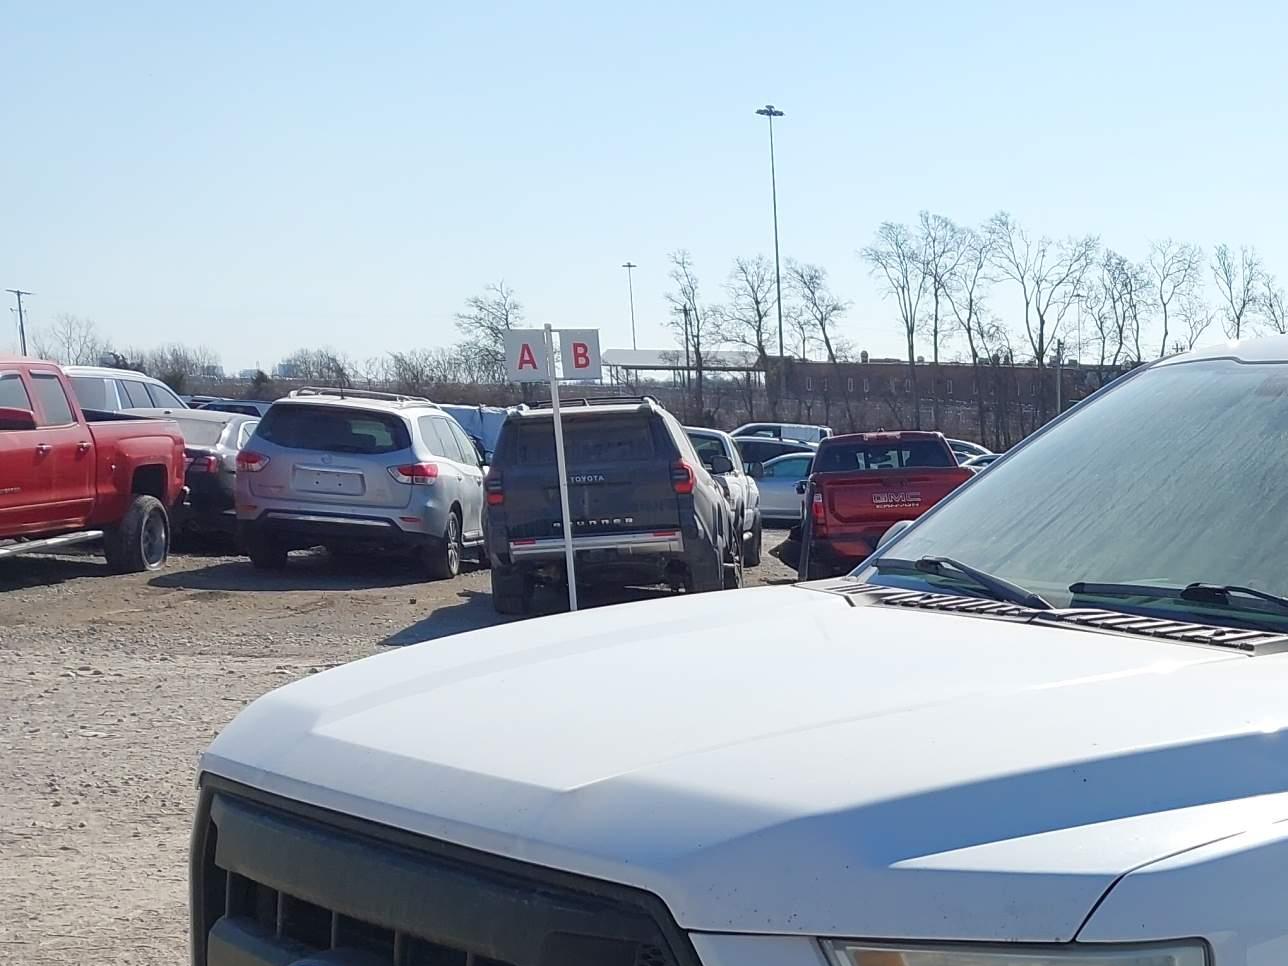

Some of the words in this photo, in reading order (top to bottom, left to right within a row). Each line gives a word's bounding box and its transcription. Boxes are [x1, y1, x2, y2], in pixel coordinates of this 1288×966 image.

[518, 343, 538, 369] A
[572, 342, 590, 368] B
[570, 474, 605, 483] TOYOTA
[872, 492, 921, 504] GMC
